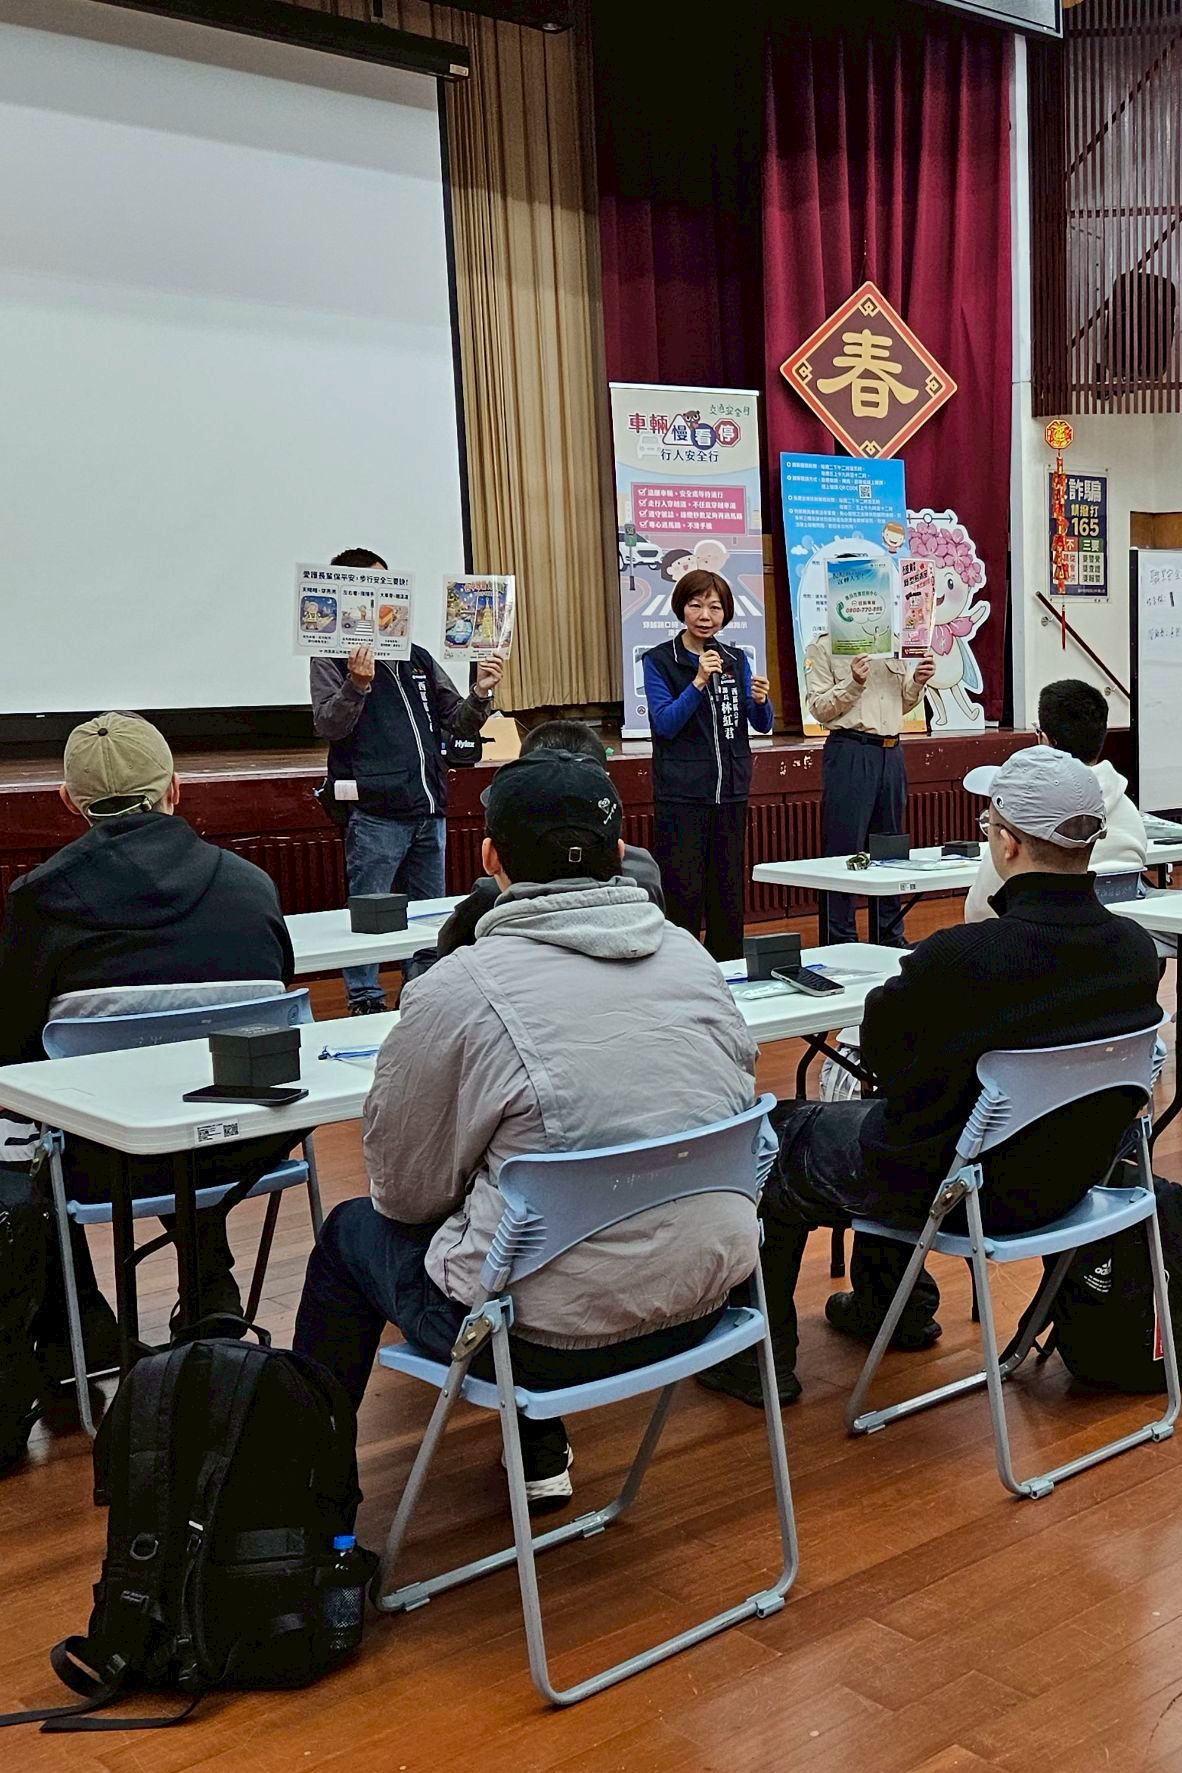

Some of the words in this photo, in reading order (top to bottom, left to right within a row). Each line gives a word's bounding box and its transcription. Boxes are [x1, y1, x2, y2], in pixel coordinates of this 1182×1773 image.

[816, 329, 919, 419] 春
[660, 449, 719, 463] 行人安全行
[1064, 478, 1102, 502] 詐騙
[1071, 504, 1099, 518] 請撥打
[1072, 517, 1100, 537] 165
